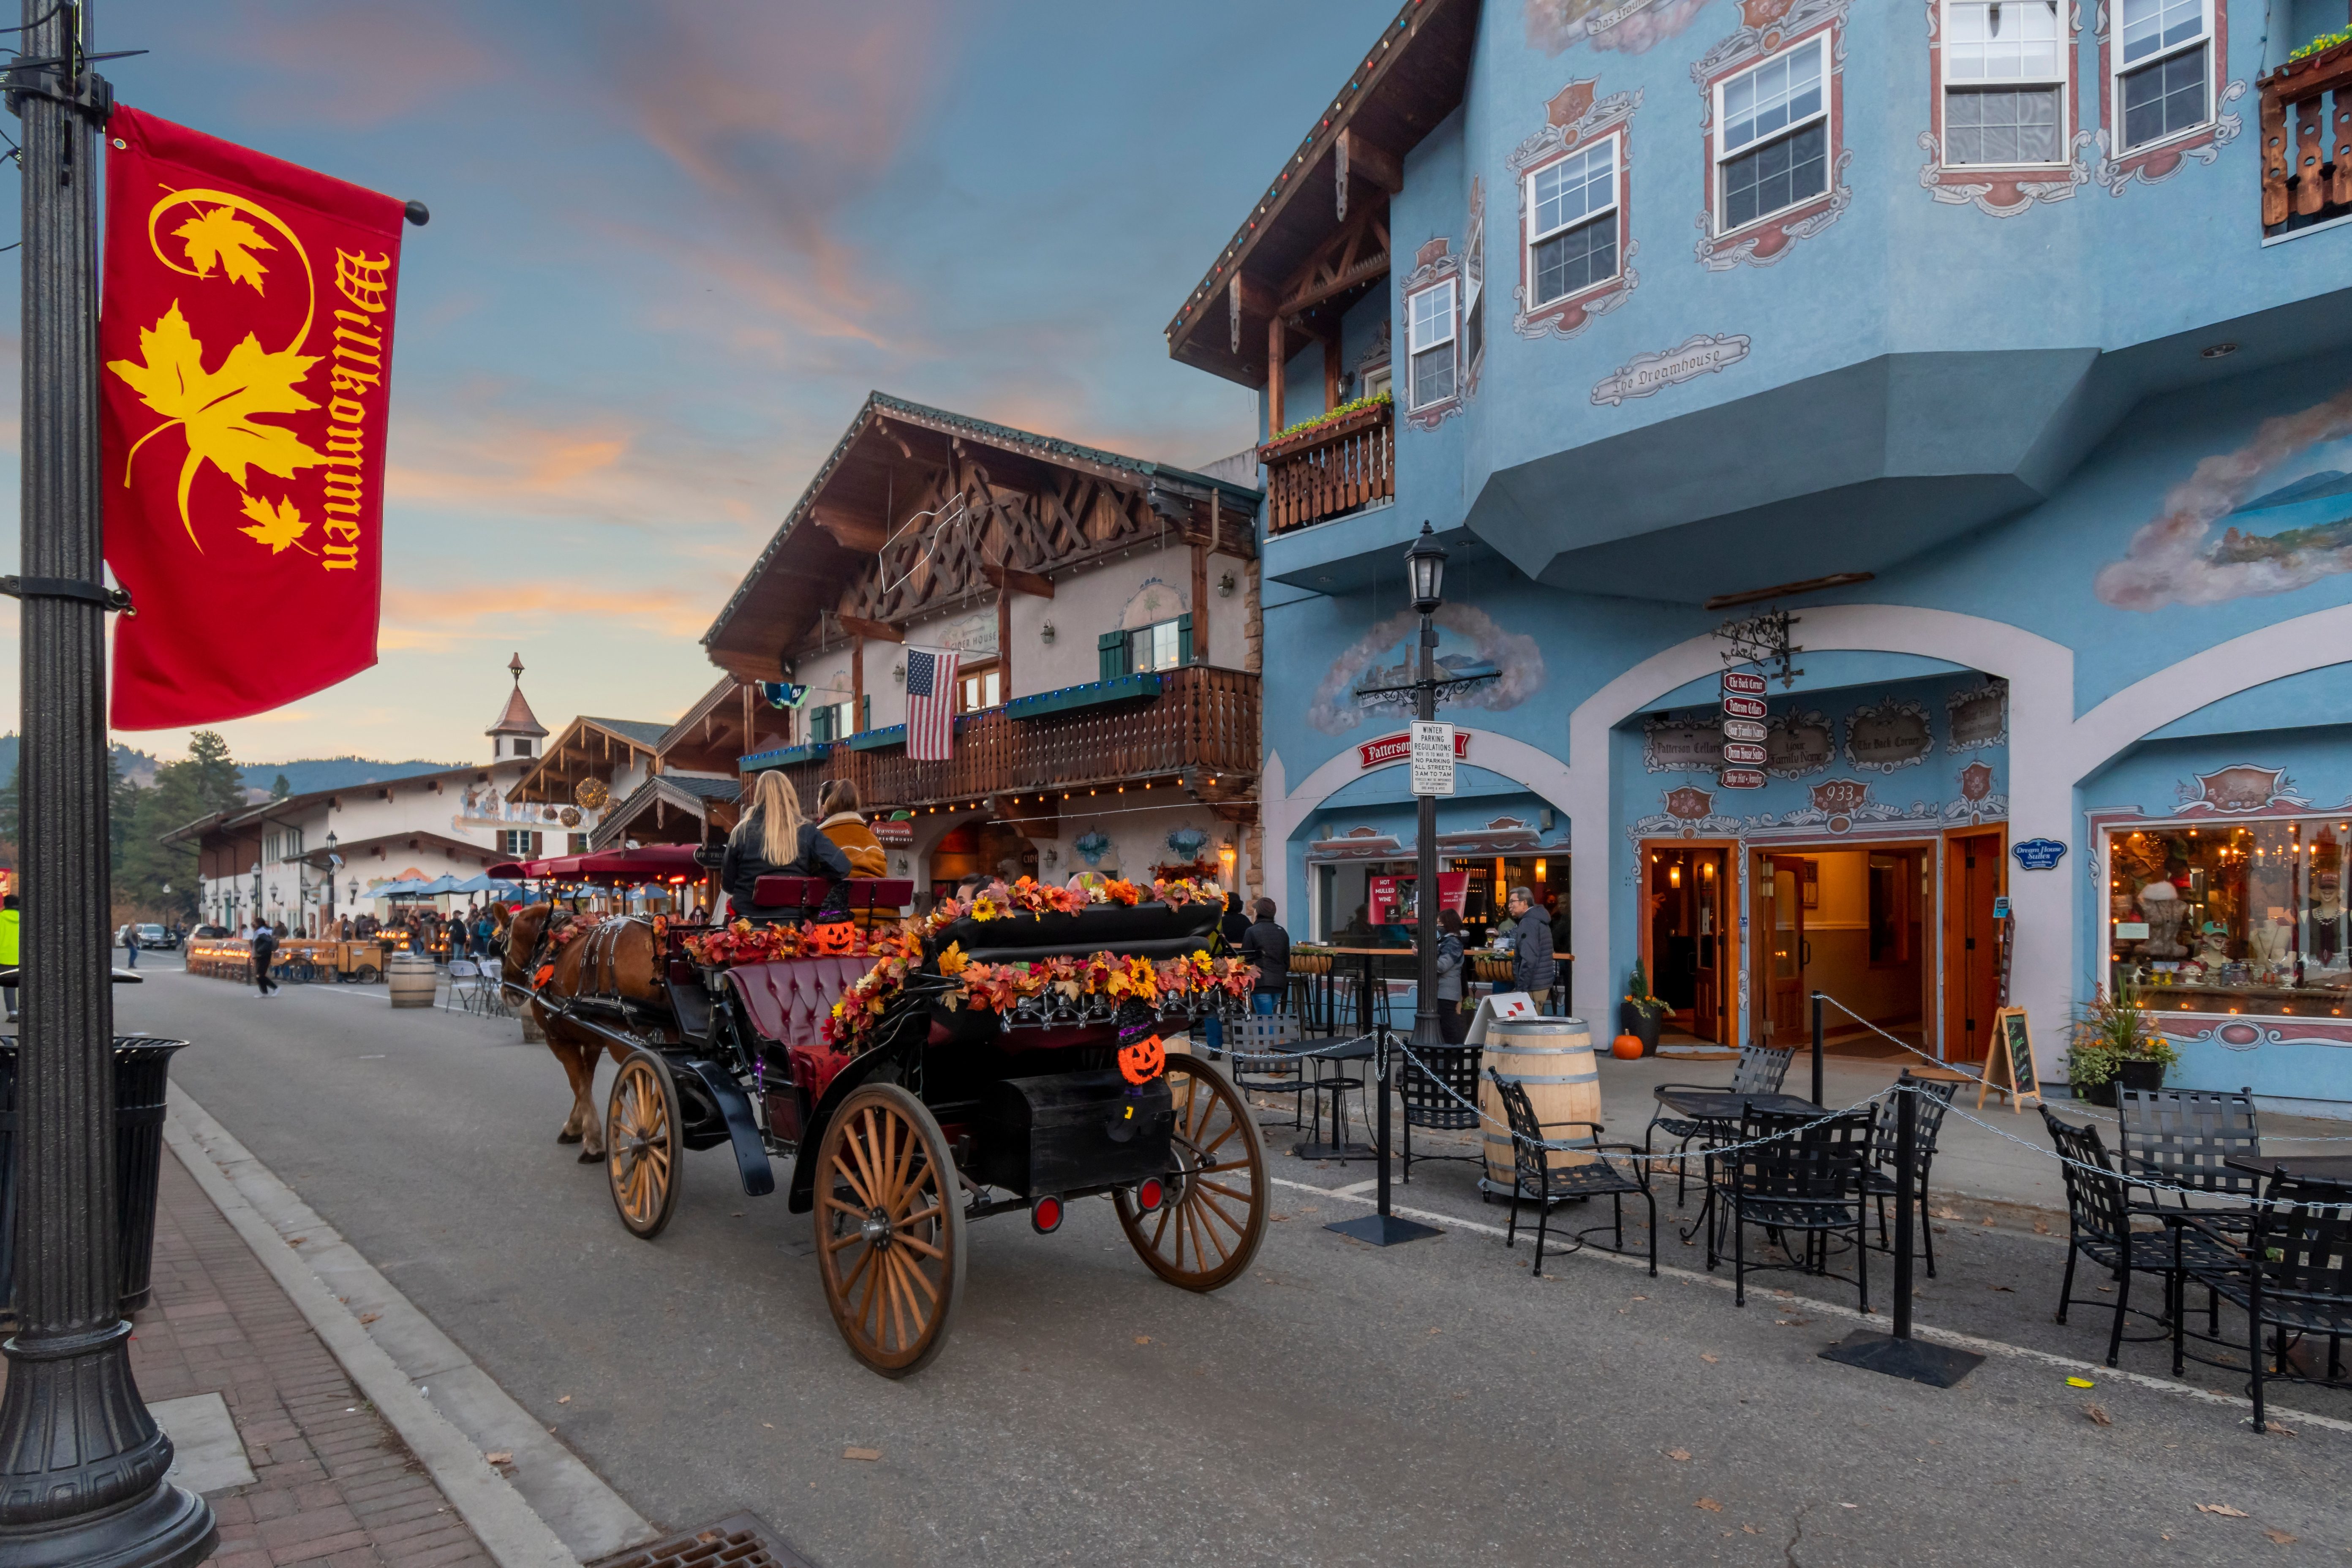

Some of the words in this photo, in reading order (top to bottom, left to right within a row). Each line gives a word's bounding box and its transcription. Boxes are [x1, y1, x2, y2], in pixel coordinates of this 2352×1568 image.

[1593, 16, 1614, 32] Das
[1613, 378, 1633, 393] The
[1639, 351, 1720, 385] Dreamhouse
[320, 247, 390, 571] Willkommen
[951, 640, 969, 649] CIDER
[973, 632, 996, 645] HOUSE
[1729, 677, 1737, 687] The
[1739, 678, 1748, 688] Back
[1749, 679, 1762, 689] Corner
[1730, 700, 1747, 713] Patterson
[1748, 702, 1762, 715] Cellars
[1728, 724, 1737, 735] Your
[1738, 724, 1752, 737] Family
[1753, 727, 1764, 738] Name
[1415, 743, 1451, 751] REGULATIONS
[1657, 742, 1690, 754] Patterson
[1694, 742, 1721, 754] Cellars
[1857, 740, 1871, 750] The
[1874, 738, 1891, 749] Back
[1895, 736, 1920, 746] Corner
[1729, 746, 1740, 758] Dream
[1741, 748, 1752, 759] House
[1753, 748, 1763, 760] Suites
[1769, 753, 1799, 765] Family
[1801, 751, 1821, 763] Name
[1726, 773, 1737, 785] Fudge
[1737, 773, 1745, 783] Hut
[1827, 786, 1854, 801] 933
[2041, 846, 2062, 854] House
[1024, 855, 1038, 863] CIDE
